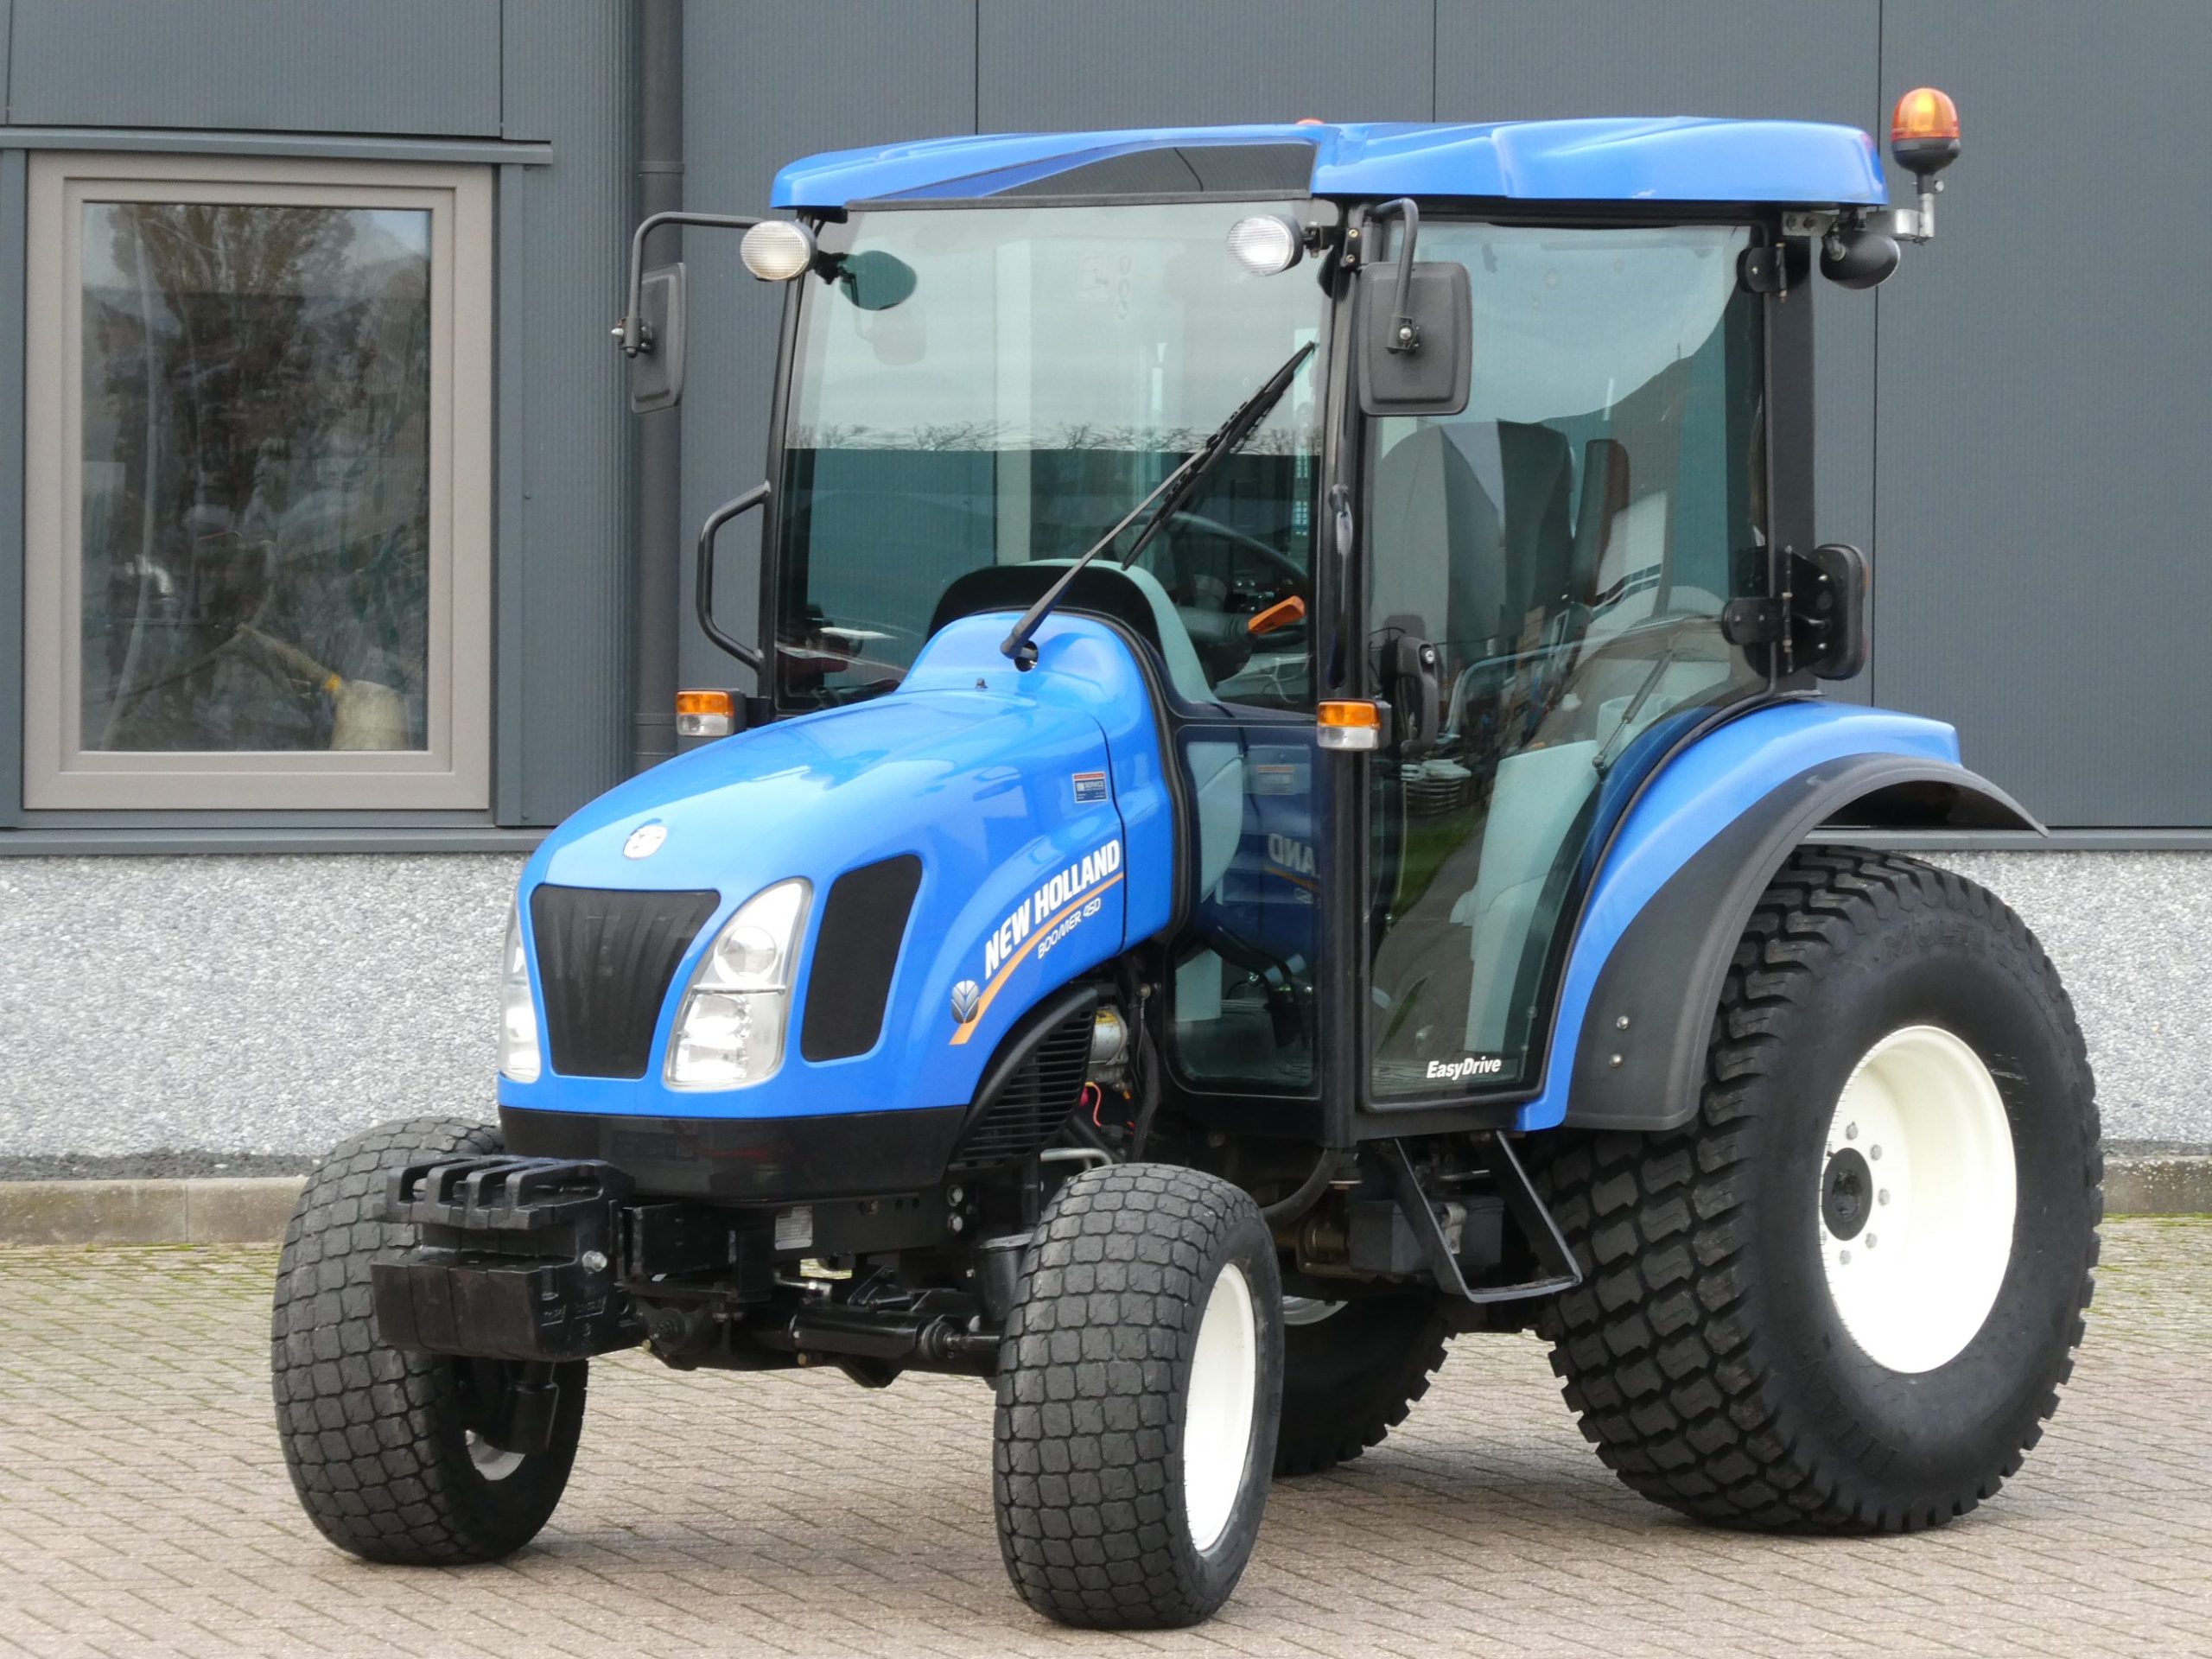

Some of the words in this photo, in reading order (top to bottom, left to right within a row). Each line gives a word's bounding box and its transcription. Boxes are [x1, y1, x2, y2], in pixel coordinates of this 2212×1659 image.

[985, 898, 1031, 980] NEW
[1033, 839, 1121, 925] HOLLAND
[1038, 910, 1082, 959] BOOMER
[1426, 1056, 1502, 1081] EasyDrive
